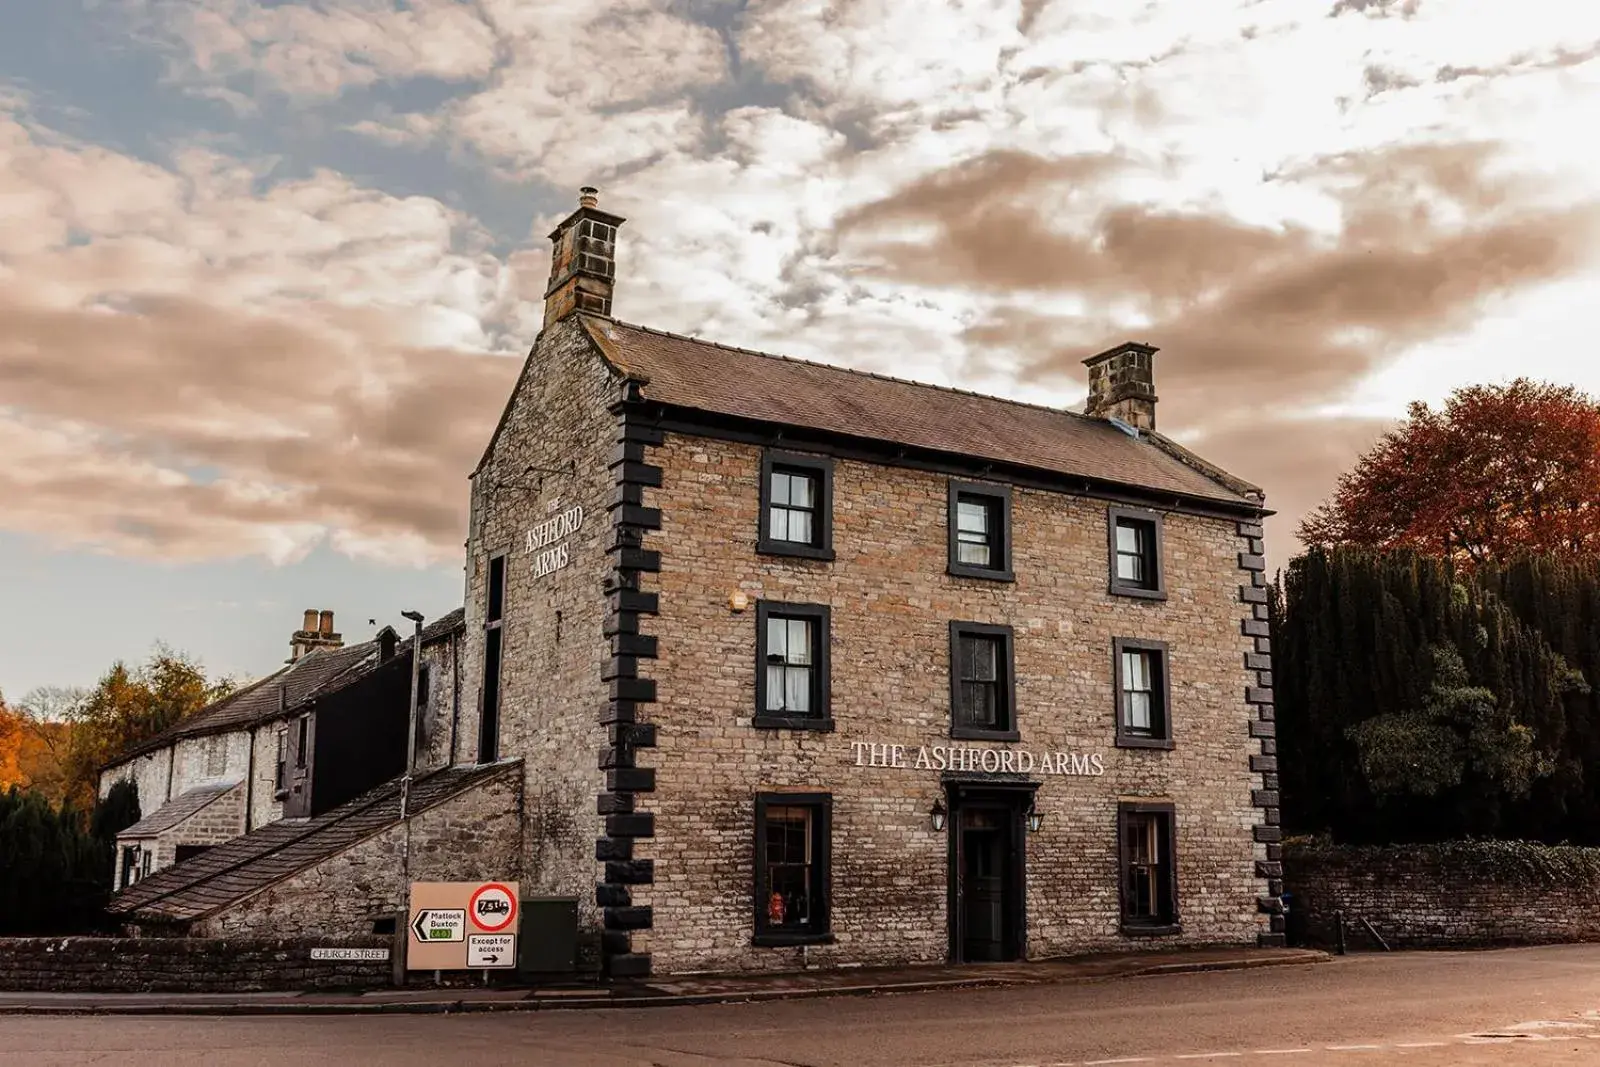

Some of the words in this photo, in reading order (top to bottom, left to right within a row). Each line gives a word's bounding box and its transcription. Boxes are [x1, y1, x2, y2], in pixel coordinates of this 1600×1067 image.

[525, 505, 583, 554] ASHFORD
[533, 541, 569, 579] ARMS
[850, 741, 906, 768] THE
[913, 746, 1034, 773] ASHFORD
[1039, 751, 1104, 776] ARMS
[431, 912, 462, 920] Matlock
[431, 920, 459, 928] Buxton
[431, 929, 451, 938] (A)
[471, 937, 498, 945] Except
[312, 950, 352, 959] CHURCH
[353, 949, 386, 959] STREET
